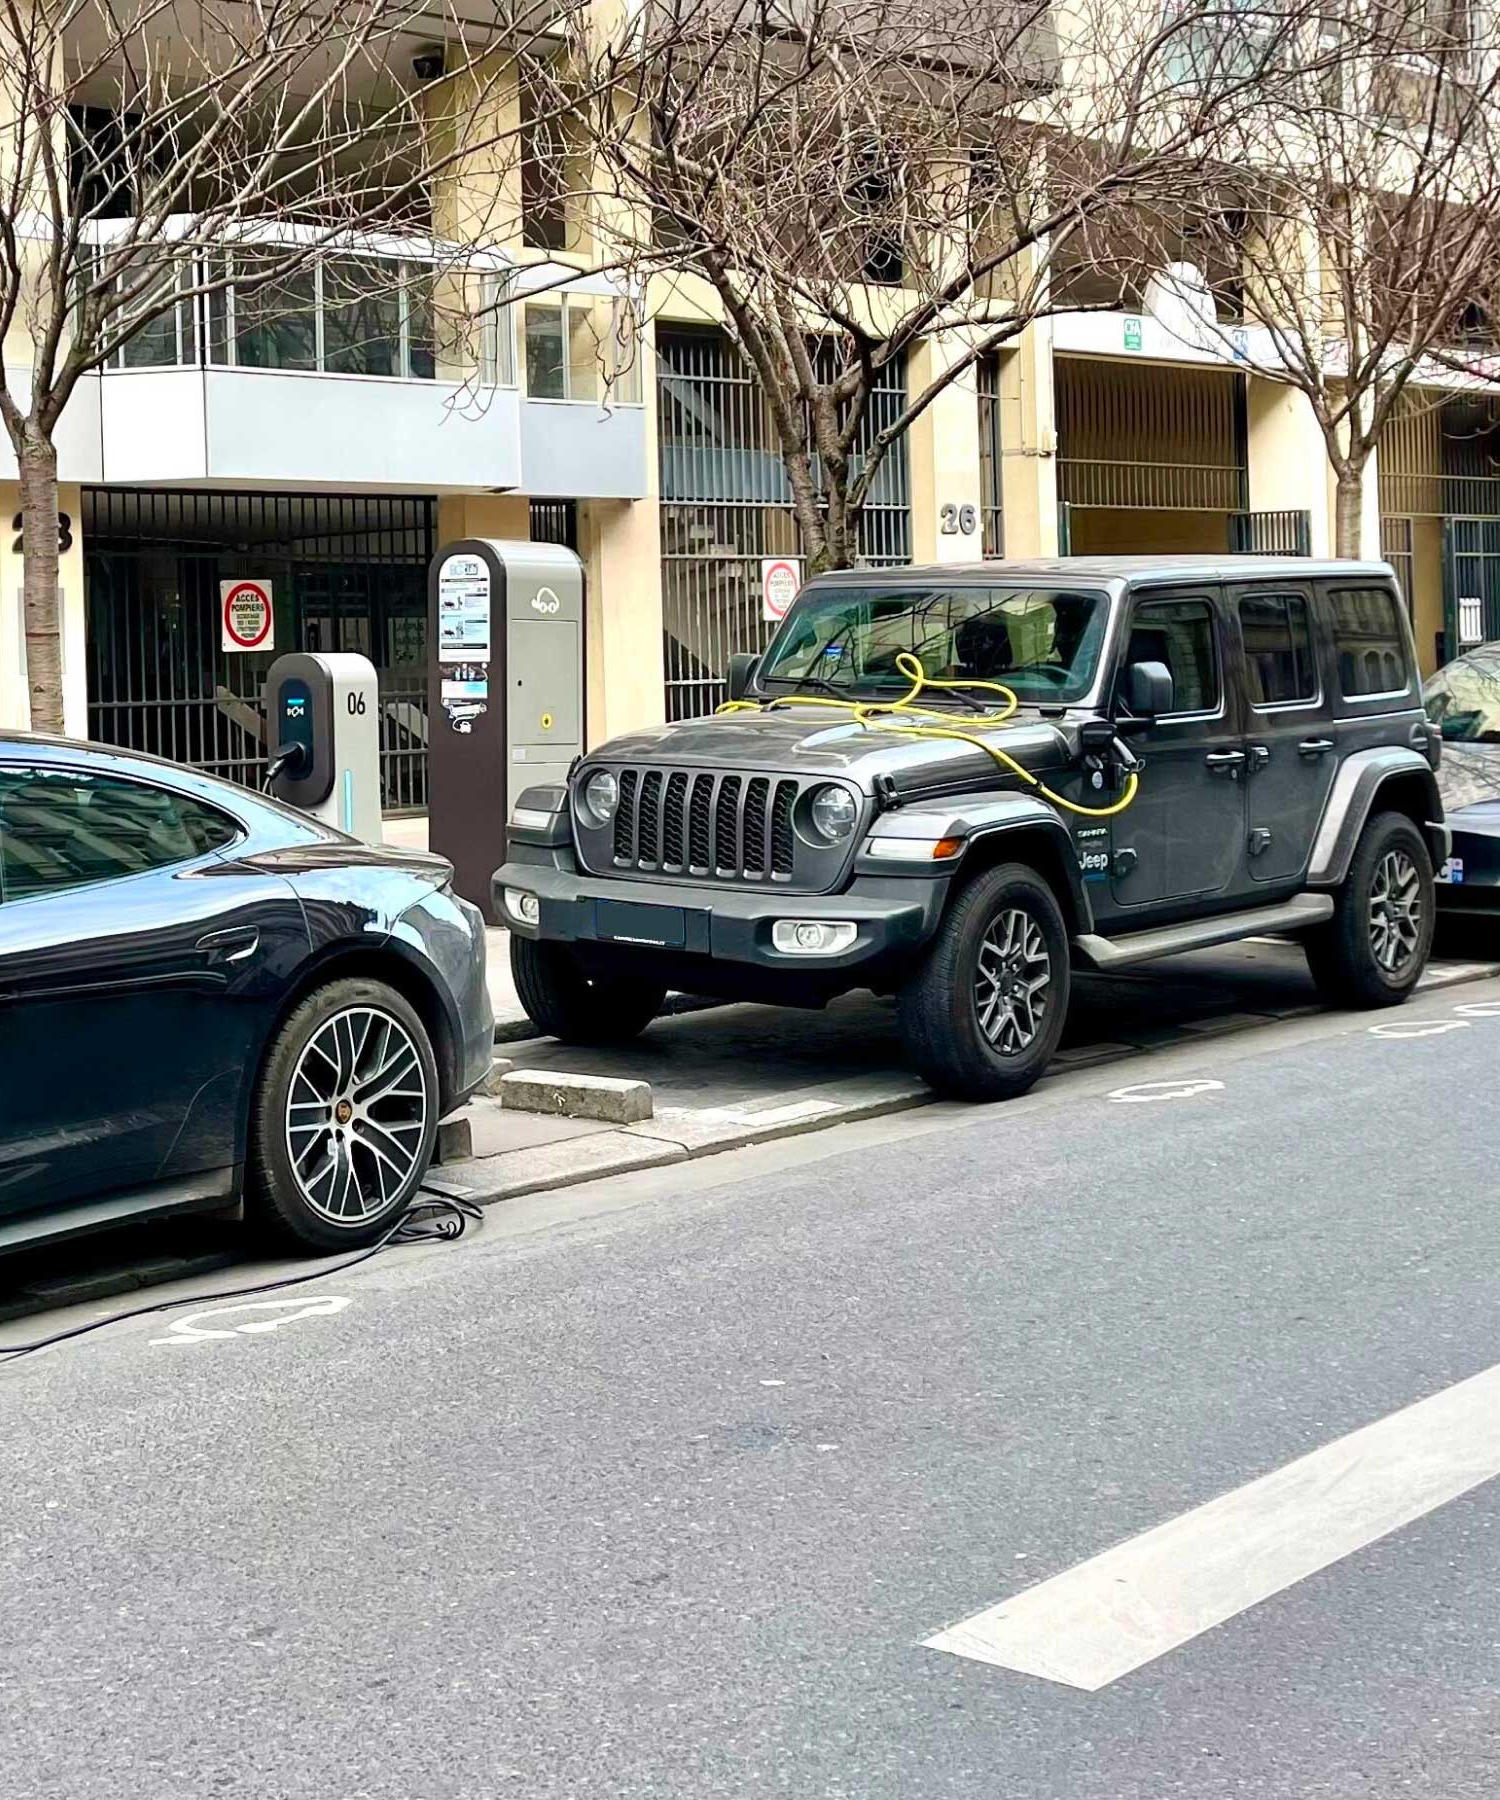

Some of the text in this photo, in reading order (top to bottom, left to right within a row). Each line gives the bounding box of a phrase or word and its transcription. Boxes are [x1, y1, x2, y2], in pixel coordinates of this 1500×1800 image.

[941, 503, 976, 535] 26
[347, 691, 366, 715] 06
[1078, 852, 1109, 870] Jeep
